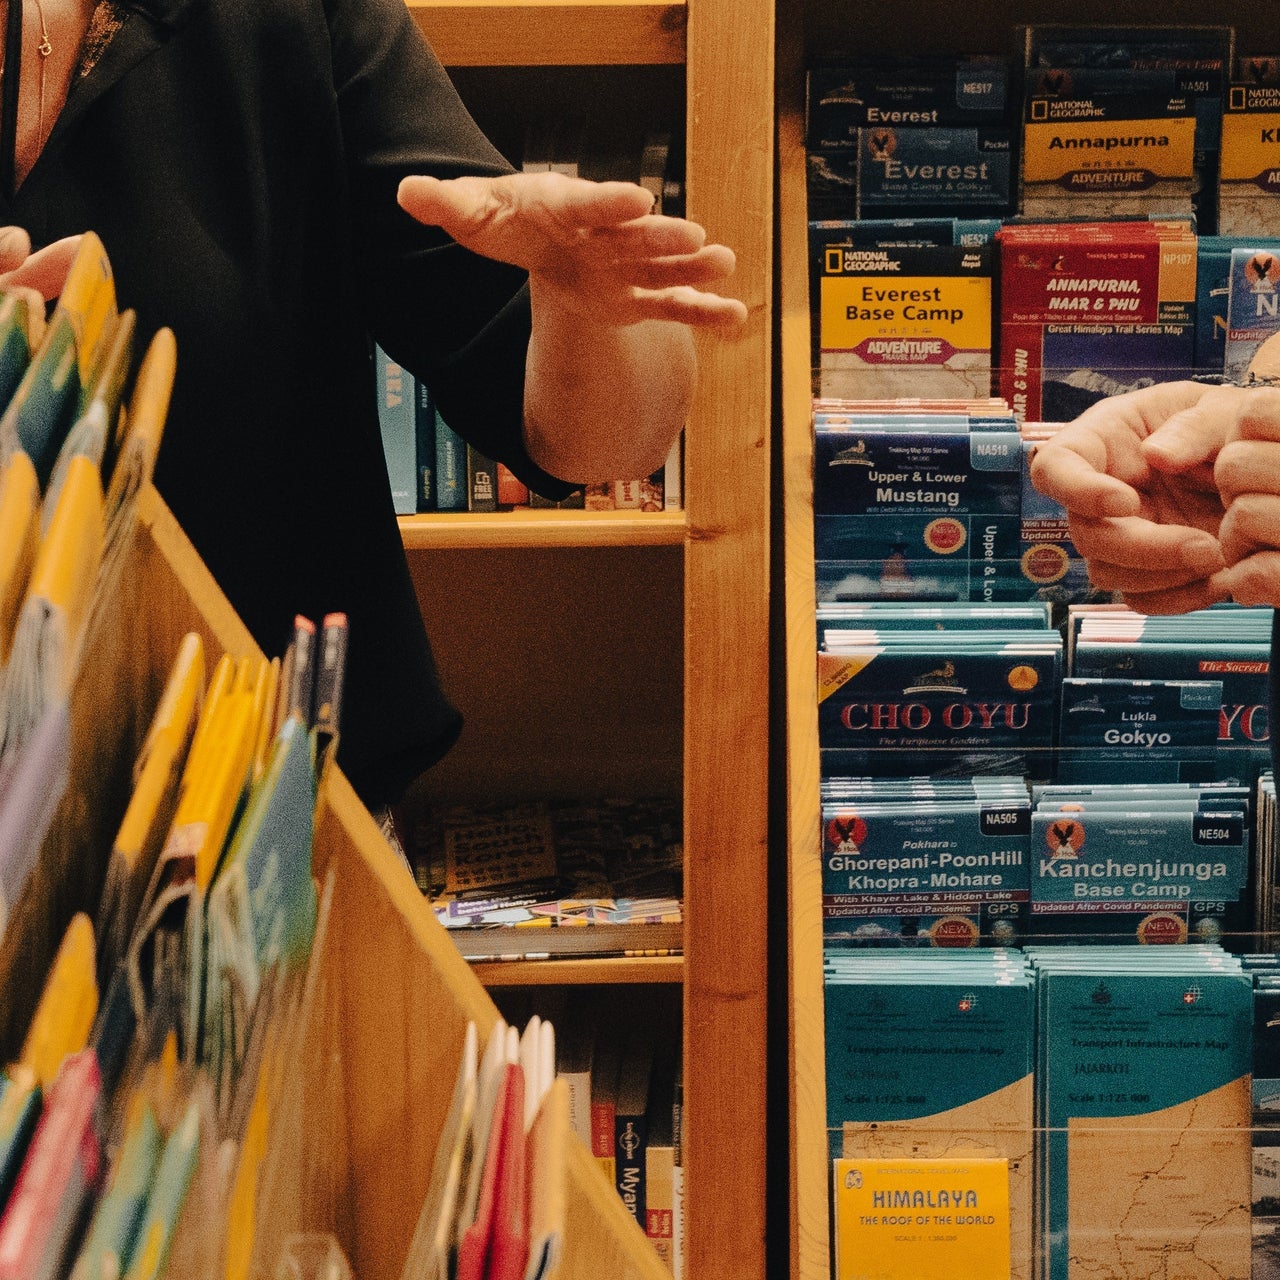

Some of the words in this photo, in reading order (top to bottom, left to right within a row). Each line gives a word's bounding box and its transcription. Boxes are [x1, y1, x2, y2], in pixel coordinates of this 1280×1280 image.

[868, 108, 937, 123] Everest
[1049, 133, 1169, 151] Annapurna
[884, 161, 987, 180] Everest
[1071, 172, 1144, 186] ADVENTURE
[844, 251, 888, 262] NATIONAL
[844, 262, 900, 272] GEOGRAPHIC
[1047, 278, 1141, 294] ANNAPURNA,
[862, 287, 941, 303] Everest
[1049, 297, 1089, 311] NAAR
[1095, 298, 1106, 311] &
[1111, 296, 1139, 311] PHU
[846, 305, 891, 321] Base
[896, 306, 963, 325] Camp
[1048, 326, 1074, 334] Great
[1077, 325, 1117, 334] Himalaya
[1120, 325, 1140, 333] Trail
[1142, 325, 1164, 333] Series
[1166, 325, 1182, 333] Map
[867, 341, 942, 355] ADVENTURE
[876, 489, 960, 505] Mustang
[841, 703, 931, 731] CHO
[943, 703, 1032, 731] OYU
[1121, 713, 1156, 721] Lukla
[1104, 729, 1171, 747] Gokyo
[986, 813, 1017, 824] NA505
[1039, 859, 1226, 879] Kanchenjunga
[1074, 882, 1126, 896] Base
[1132, 884, 1191, 899] Camp
[828, 906, 867, 915] Updated
[870, 906, 894, 914] After
[896, 905, 920, 914] Covid
[922, 905, 971, 913] Pandemic
[988, 903, 1018, 914] GPS
[1194, 902, 1224, 913] GPS
[873, 1190, 978, 1208] HIMALAYA
